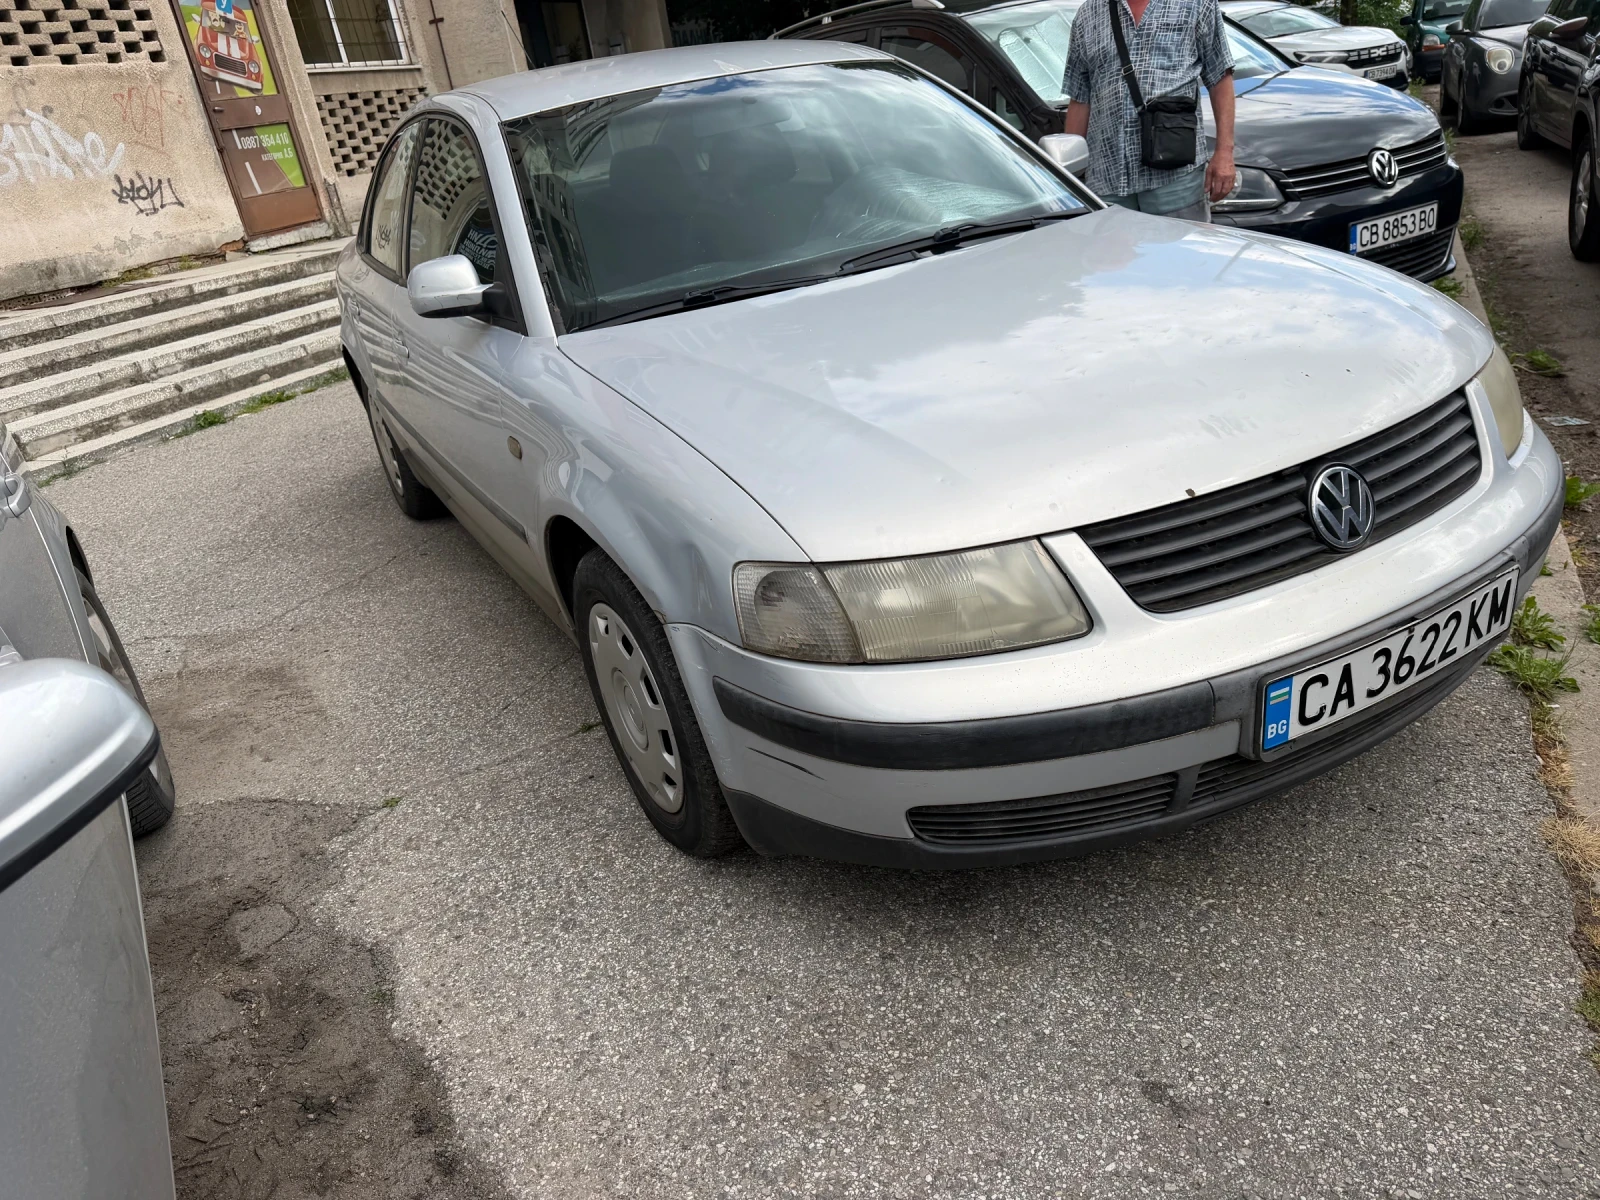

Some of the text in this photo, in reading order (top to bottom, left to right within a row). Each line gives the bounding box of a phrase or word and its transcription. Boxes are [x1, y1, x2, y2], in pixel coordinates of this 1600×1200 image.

[240, 135, 260, 149] 0887
[260, 133, 275, 147] 354
[1360, 223, 1379, 247] CB
[1383, 213, 1416, 241] 8853
[1419, 207, 1435, 231] BO
[1267, 578, 1513, 740] BG CA 3622 KM
